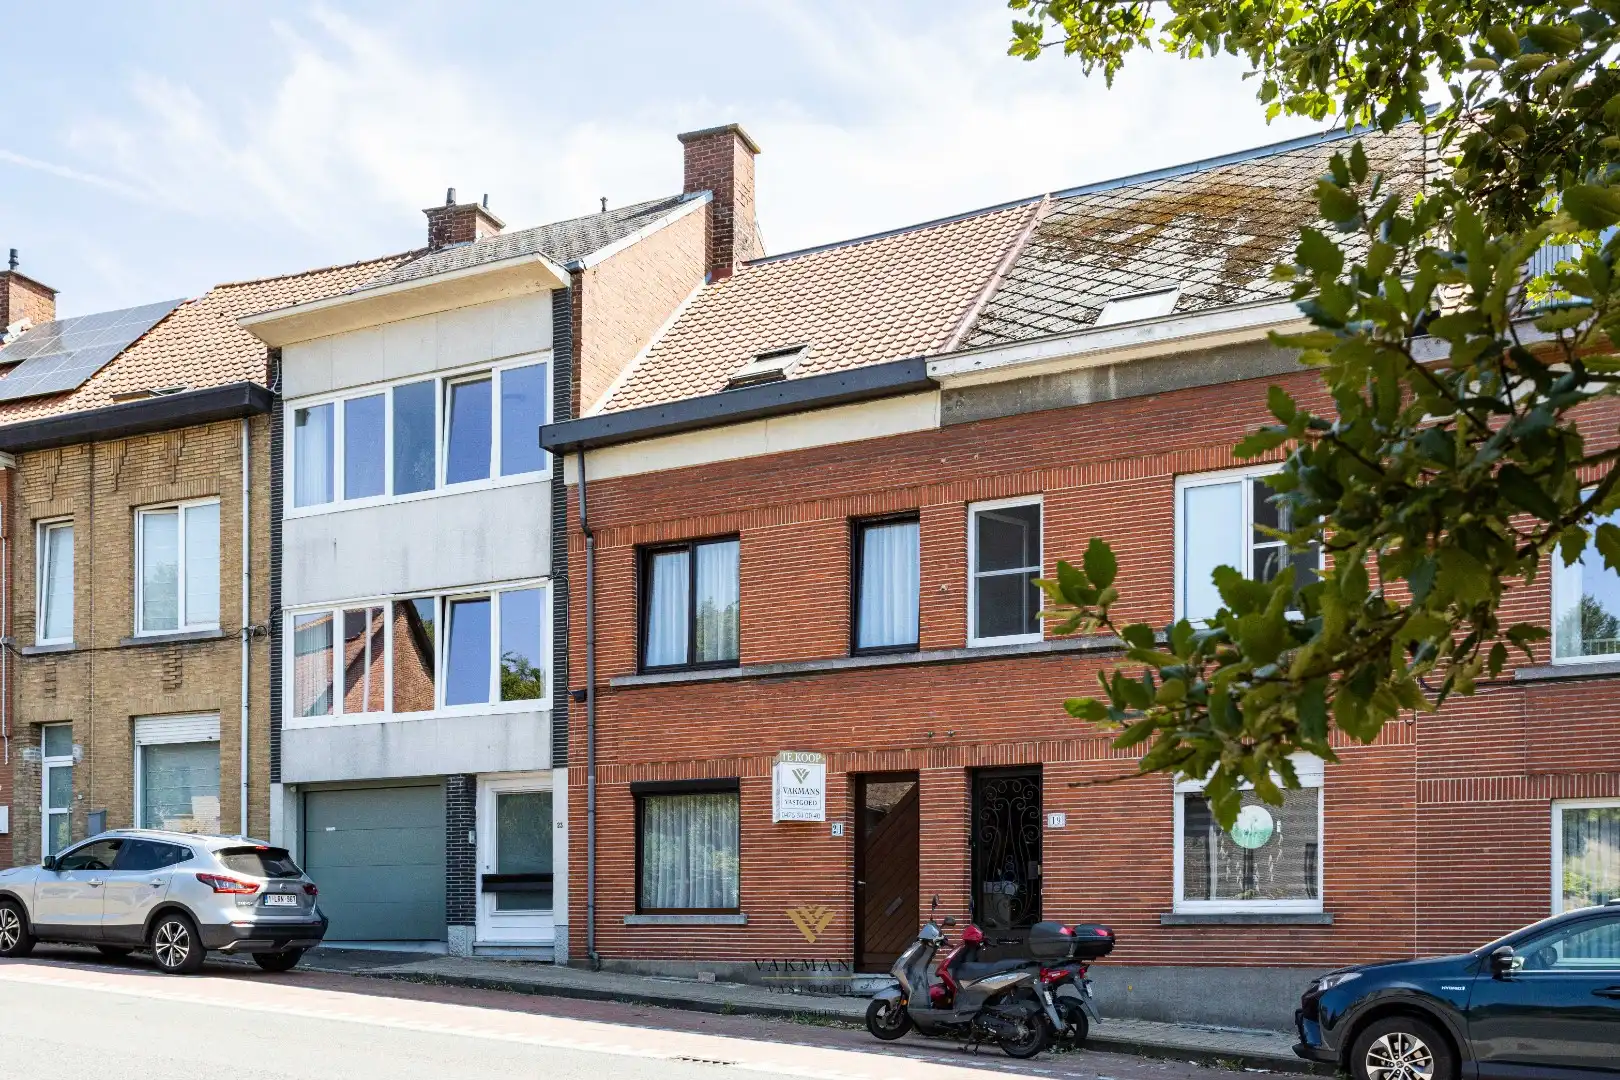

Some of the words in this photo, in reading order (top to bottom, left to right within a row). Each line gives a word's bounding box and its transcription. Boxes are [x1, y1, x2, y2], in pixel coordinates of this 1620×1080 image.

[782, 752, 793, 761] TE
[795, 753, 821, 763] KOOP
[782, 786, 820, 796] VAKMANS
[1052, 816, 1061, 825] 19
[832, 824, 842, 835] 21
